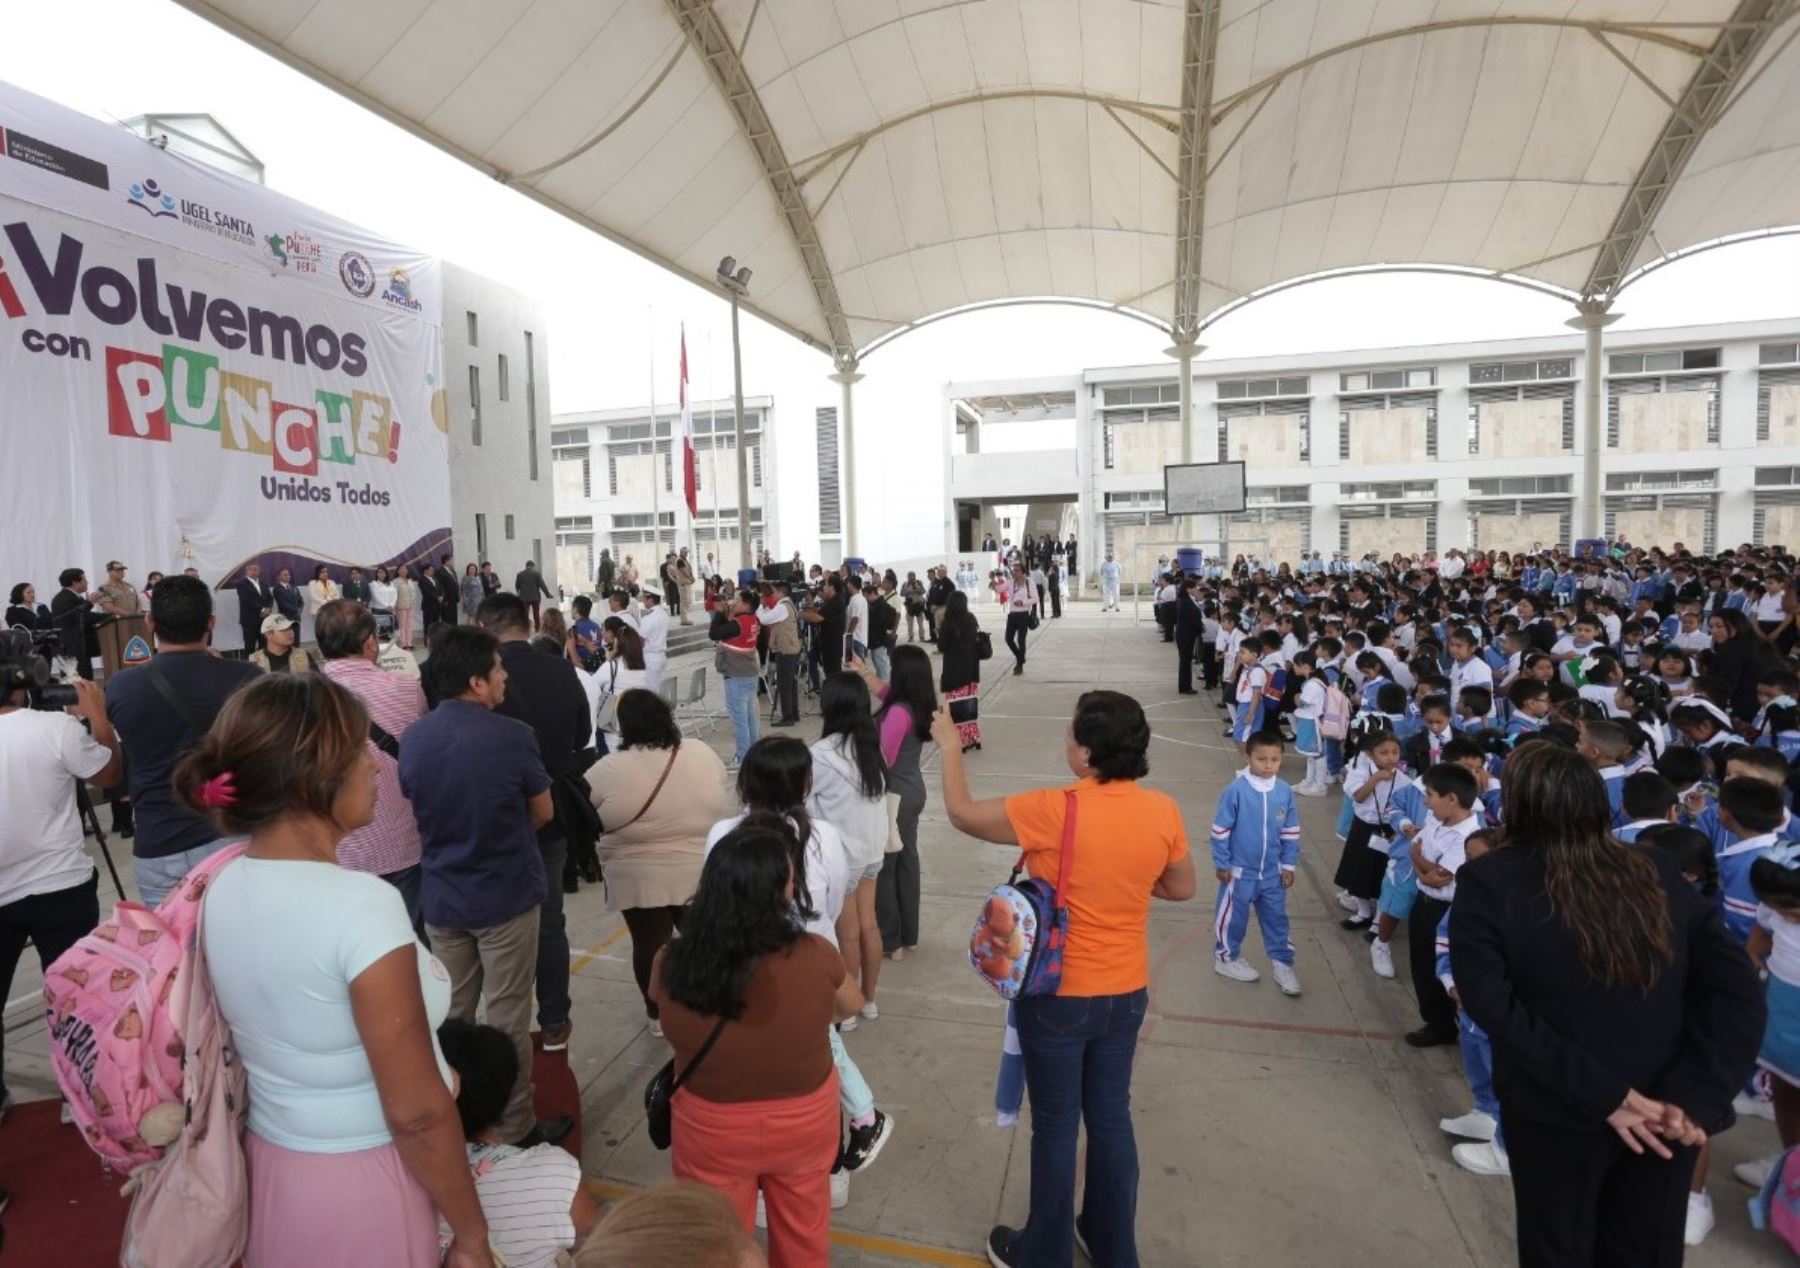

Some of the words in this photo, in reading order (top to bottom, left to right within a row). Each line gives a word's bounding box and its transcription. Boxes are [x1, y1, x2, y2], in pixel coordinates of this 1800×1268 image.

[181, 198, 212, 223] UGEL
[214, 211, 255, 238] SANTA
[382, 289, 422, 312] Ancash
[22, 329, 91, 361] con
[117, 356, 401, 466] PUNCHE!
[261, 476, 331, 503] Unidos
[337, 481, 391, 507] Todos
